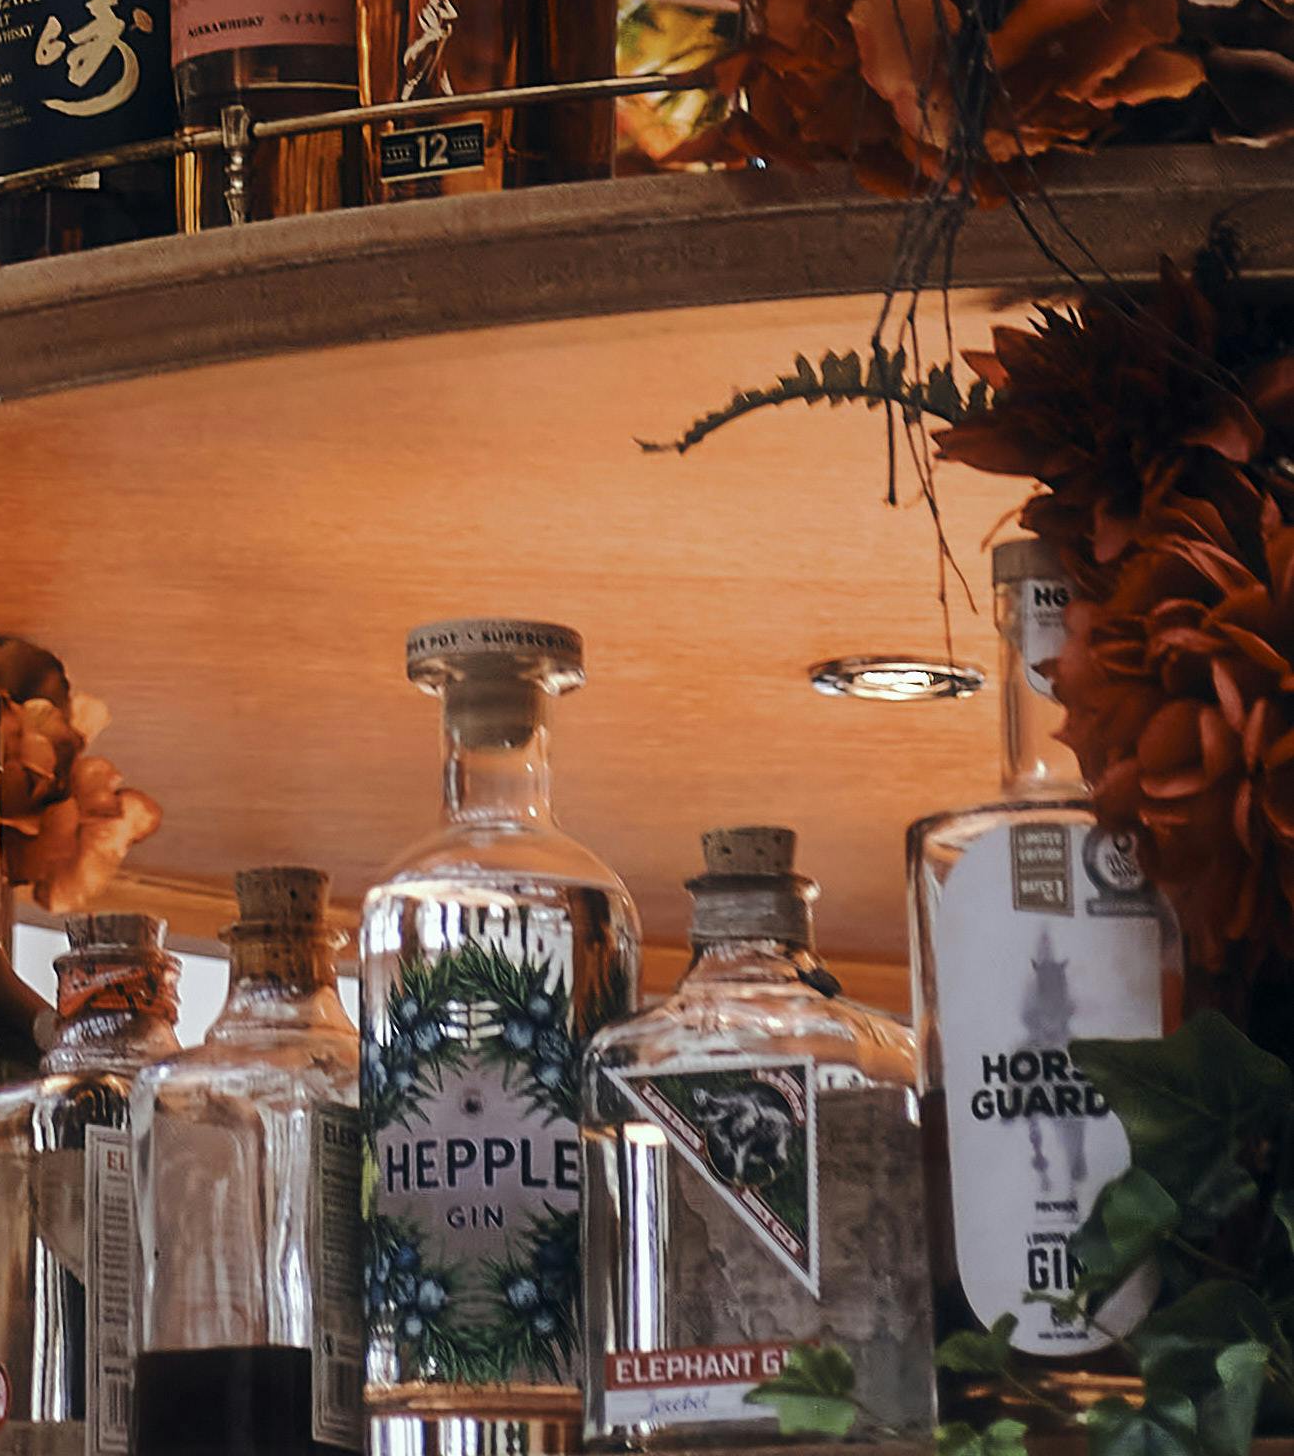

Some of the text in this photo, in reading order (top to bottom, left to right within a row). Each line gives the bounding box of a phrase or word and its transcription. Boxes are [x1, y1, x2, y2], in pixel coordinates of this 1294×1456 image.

[416, 133, 449, 168] 12
[981, 1050, 1088, 1084] HOR
[971, 1086, 1110, 1120] GUARD
[386, 1137, 579, 1193] HEPPLE
[446, 1204, 504, 1229] GIN
[615, 1349, 756, 1383] ELEPHANT
